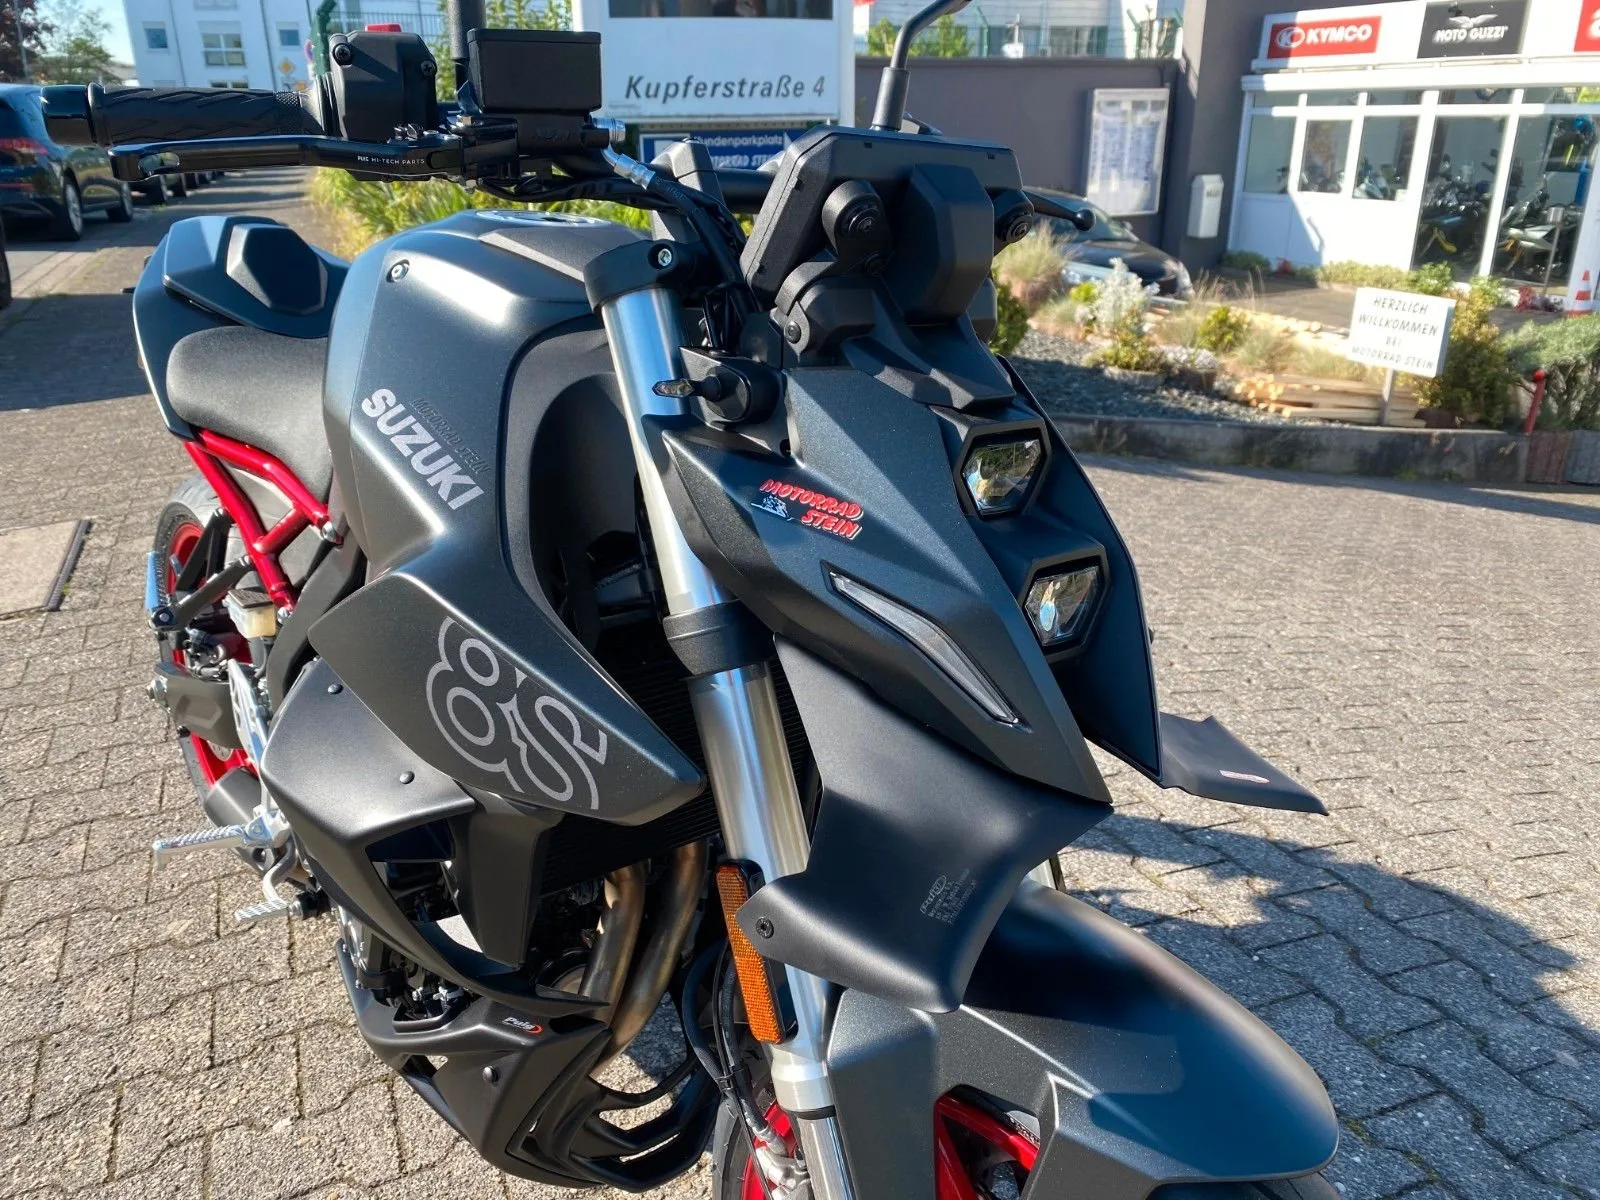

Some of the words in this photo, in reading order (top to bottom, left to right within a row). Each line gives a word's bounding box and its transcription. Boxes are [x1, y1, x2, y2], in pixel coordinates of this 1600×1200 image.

[1306, 24, 1373, 45] KYMCO
[1434, 28, 1467, 42] MOTO
[1469, 26, 1505, 40] GUZZI
[625, 74, 805, 104] Kupferstraße
[813, 75, 826, 97] 4
[1373, 296, 1429, 315] HERZLICH
[1358, 312, 1440, 336] WILLKOMMEN
[1404, 356, 1434, 369] STEIN
[361, 388, 485, 511] SUZUKI
[759, 479, 864, 520] MOTORRAD
[801, 509, 863, 540] STEIN
